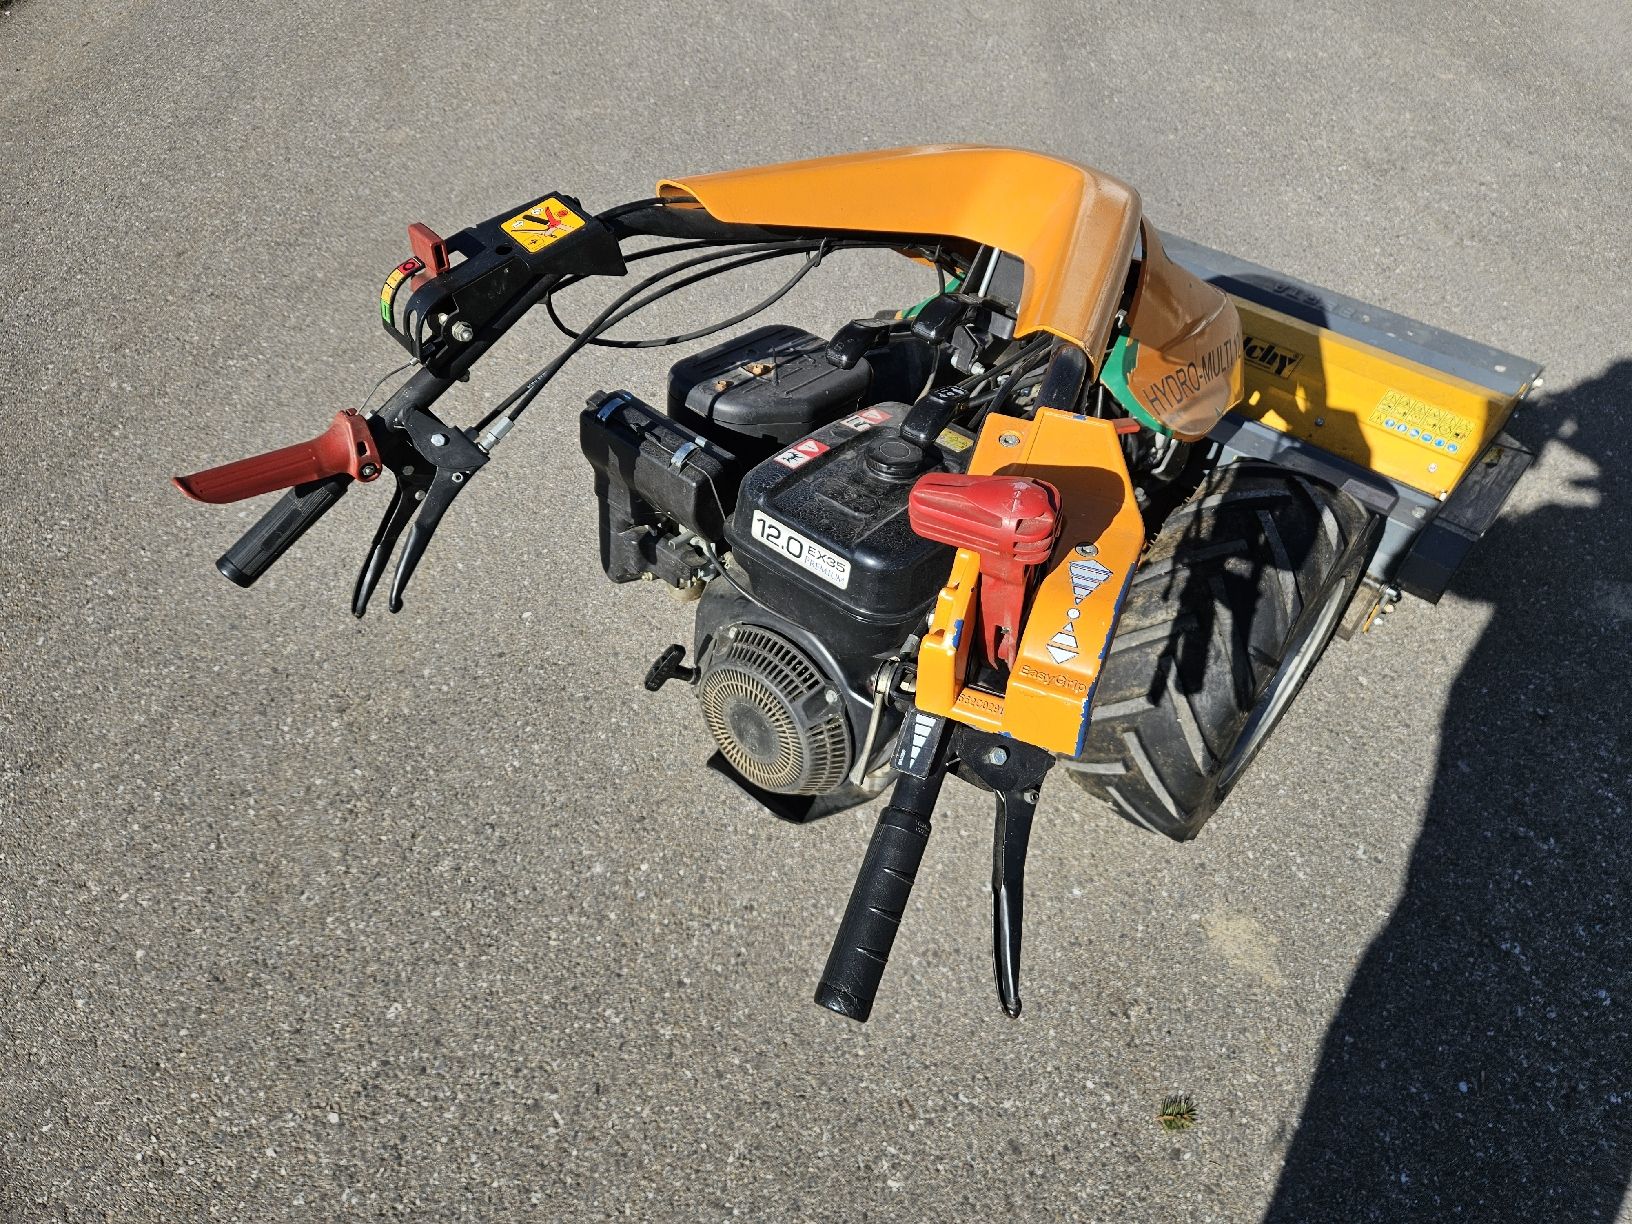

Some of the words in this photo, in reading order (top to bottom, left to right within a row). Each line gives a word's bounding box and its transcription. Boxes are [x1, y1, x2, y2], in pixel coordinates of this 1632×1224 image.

[1143, 339, 1233, 416] HYDRO-MULTI
[757, 518, 803, 559] 12.0
[804, 556, 845, 582] PREMIUM
[807, 545, 846, 573] EX35
[1021, 664, 1087, 694] EasyGrip
